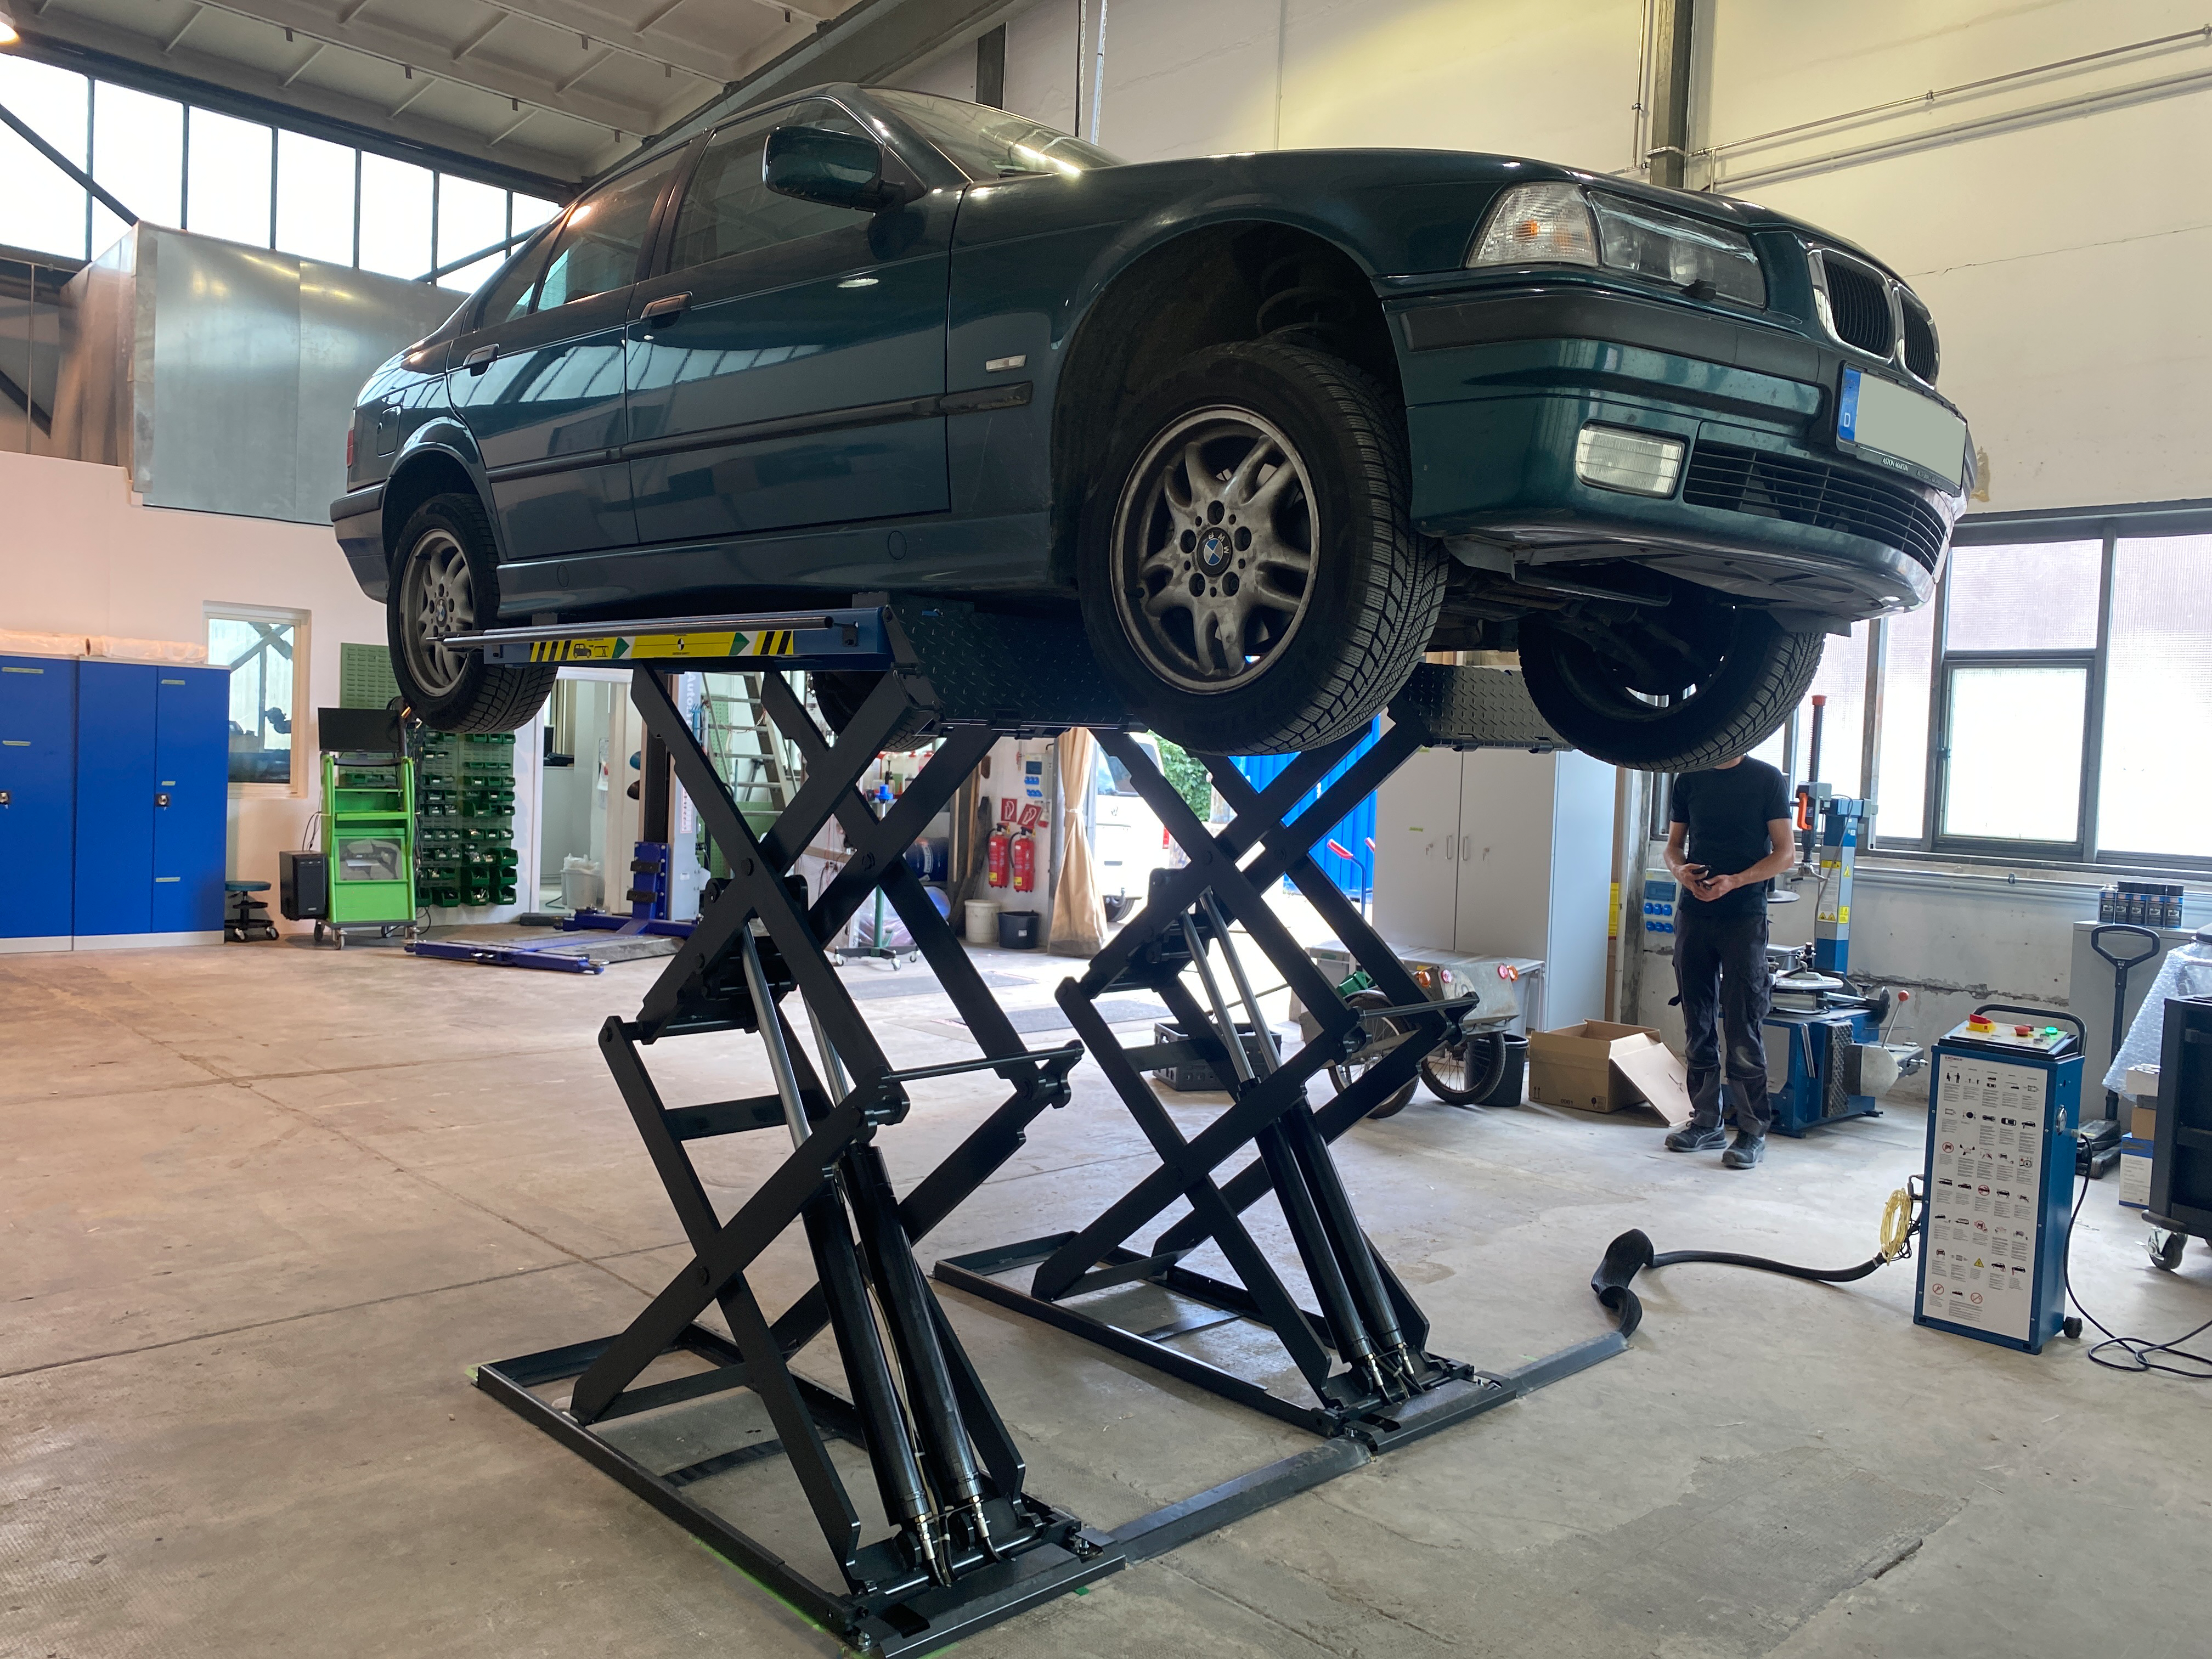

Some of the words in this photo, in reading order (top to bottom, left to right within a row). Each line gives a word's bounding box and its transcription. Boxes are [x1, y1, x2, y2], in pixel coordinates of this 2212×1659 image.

[1843, 412, 1850, 427] D
[1882, 457, 1895, 467] ASTON
[1895, 461, 1909, 472] MARTIN
[1208, 532, 1229, 554] BMW
